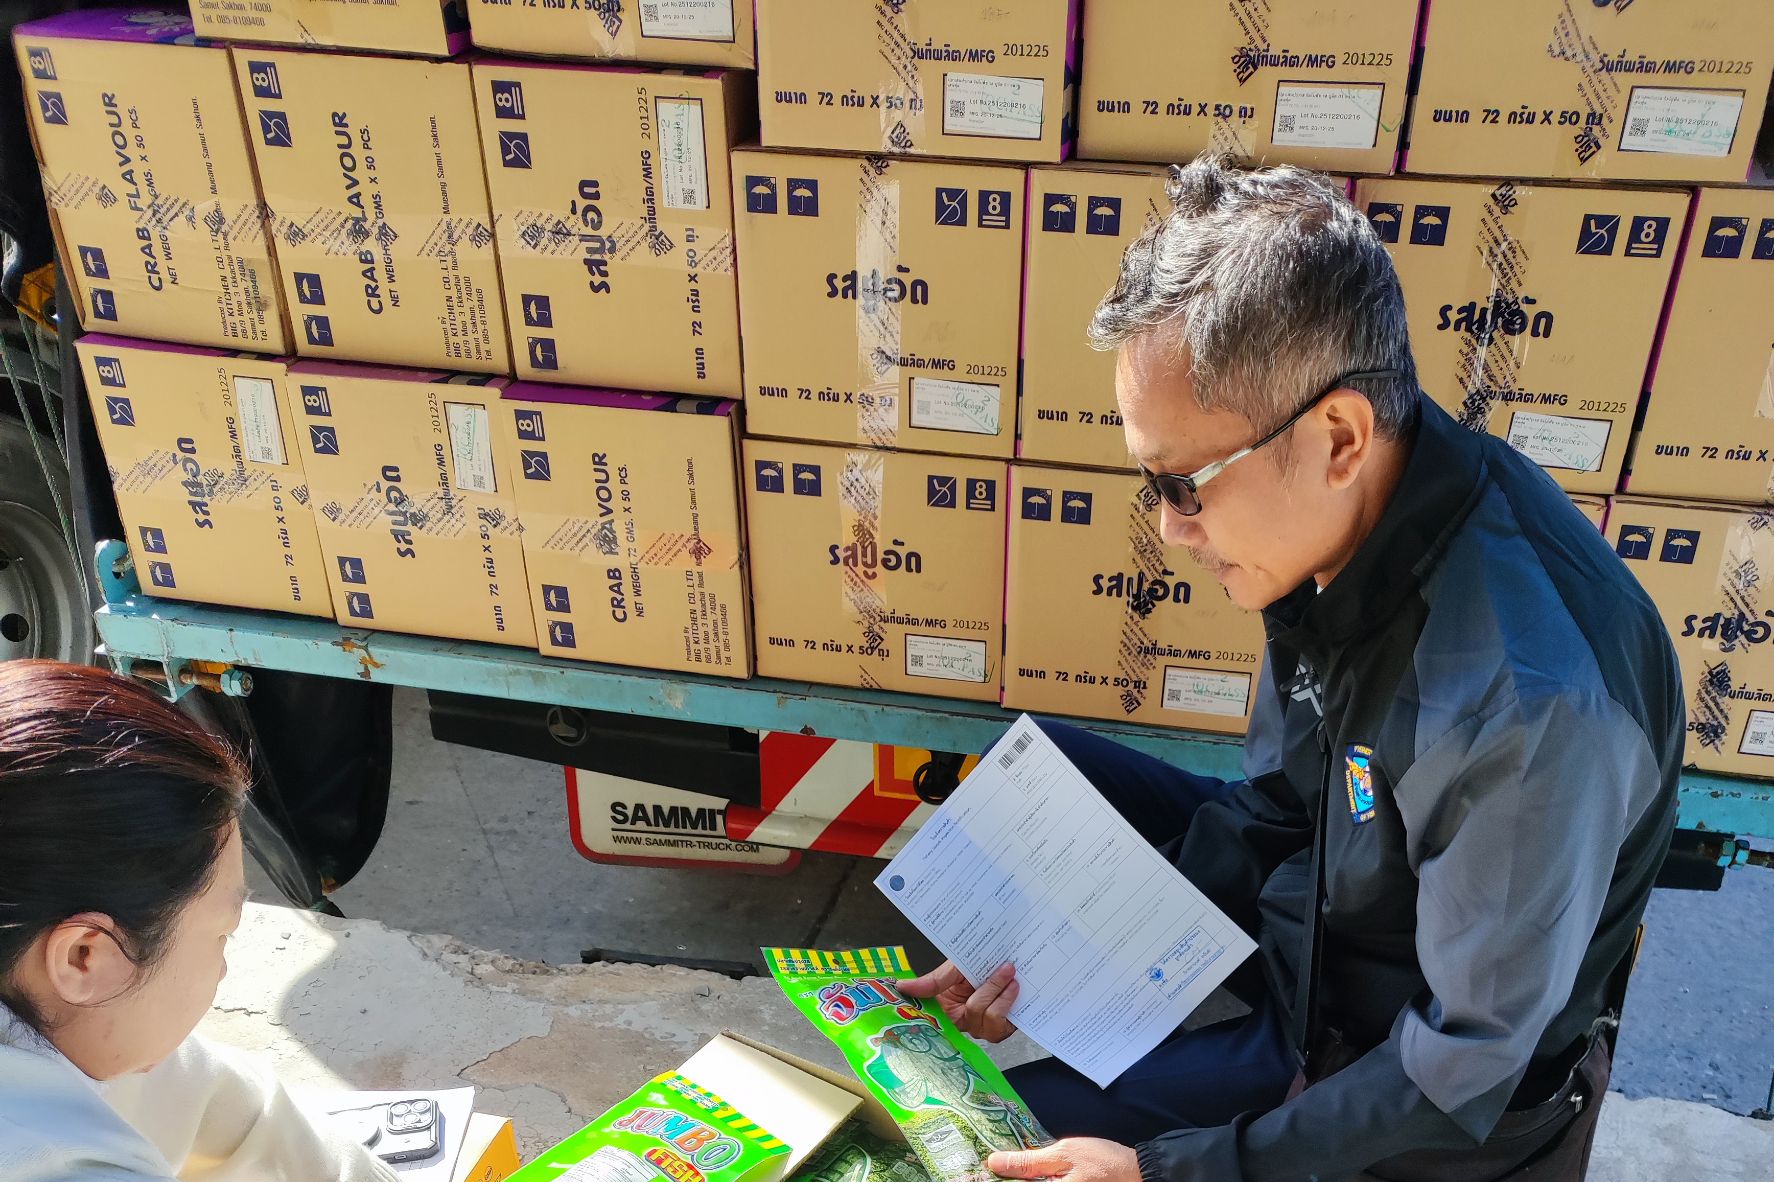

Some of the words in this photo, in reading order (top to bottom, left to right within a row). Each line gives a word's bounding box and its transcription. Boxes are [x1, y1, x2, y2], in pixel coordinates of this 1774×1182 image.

[1002, 43, 1049, 58] 201225
[1342, 51, 1394, 67] 201225
[1697, 58, 1754, 75] 201225
[252, 72, 269, 87] 8
[496, 92, 512, 108] 8
[774, 90, 808, 105] ขนาด
[817, 92, 834, 107] 72
[840, 88, 865, 108] กรัม
[869, 94, 880, 108] X
[1096, 99, 1131, 114] ขนาด
[1142, 100, 1159, 115] 72
[1166, 97, 1192, 117] กรัม
[1196, 102, 1208, 118] X
[1213, 103, 1234, 119] 50
[128, 105, 142, 130] PCS.
[637, 87, 650, 140] 201225
[1432, 108, 1470, 124] ขนาด
[1481, 108, 1500, 124] 72
[1507, 105, 1536, 125] กรัม
[1540, 110, 1553, 125] X
[1557, 110, 1580, 126] 50
[135, 134, 146, 150] 50
[198, 132, 211, 160] Samut
[359, 124, 375, 150] PCS.
[102, 91, 145, 213] FLAVOUR
[140, 154, 149, 163] X
[364, 156, 376, 171] 50
[432, 153, 445, 179] Samut
[369, 176, 379, 185] X
[987, 193, 1001, 215] 8
[1640, 220, 1657, 243] 8
[136, 226, 163, 291] CRAB
[686, 248, 697, 269] 50
[168, 265, 179, 285] NET
[237, 256, 246, 285] 74000
[687, 273, 699, 284] X
[359, 249, 384, 315] CRAB
[464, 276, 473, 303] 74000
[221, 275, 236, 317] KITCHEN
[388, 288, 401, 308] NET
[686, 287, 701, 314] กรัม
[449, 295, 460, 338] KITCHEN
[228, 322, 239, 338] BIG
[692, 320, 703, 337] 72
[454, 341, 463, 359] BIG
[696, 347, 706, 380] ขนาด
[965, 363, 1008, 378] 201225
[216, 367, 232, 407] 201225
[758, 385, 788, 399] ขนาด
[797, 388, 812, 400] 72
[818, 386, 840, 403] กรัม
[843, 391, 853, 404] X
[427, 392, 442, 434] 201225
[1037, 409, 1069, 422] ขนาด
[1078, 411, 1094, 424] 72
[1578, 399, 1628, 414] 201225
[517, 418, 533, 431] 8
[1654, 443, 1690, 458] ขนาด
[1700, 446, 1719, 459] 72
[1725, 444, 1752, 462] กรัม
[1755, 449, 1769, 463] X
[617, 464, 630, 486] PCS.
[621, 489, 631, 502] 50
[689, 487, 698, 511] Samut
[975, 481, 987, 499] 8
[272, 495, 284, 512] 50
[623, 506, 632, 514] X
[276, 516, 287, 525] X
[626, 518, 635, 543] GMS.
[278, 528, 291, 548] กรัม
[477, 524, 489, 541] 50
[482, 544, 492, 554] X
[629, 546, 638, 561] 72
[828, 538, 922, 580] รสปูอัด
[284, 553, 295, 567] 72
[482, 556, 495, 578] กรัม
[289, 575, 301, 602] ขนาด
[489, 582, 500, 597] 72
[606, 567, 628, 623] CRAB
[635, 605, 645, 618] NET
[708, 592, 716, 615] 74000
[491, 605, 505, 632] ขนาด
[690, 601, 700, 644] KITCHEN
[952, 619, 990, 631] 201225
[702, 626, 710, 640] Moo
[694, 645, 703, 663] BIG
[714, 643, 722, 666] Samut
[768, 636, 795, 648] ขนาด
[803, 639, 817, 650] 72
[822, 639, 843, 653] กรัม
[846, 644, 855, 654] X
[858, 645, 874, 656] 50
[1215, 650, 1257, 663] 201225
[1018, 667, 1046, 680] ขนาด
[1055, 670, 1069, 682] 72
[1075, 671, 1096, 685] กรัม
[1099, 676, 1109, 687] X
[1112, 677, 1128, 688] 50
[610, 801, 727, 832] SAMMIT
[612, 835, 760, 853] WWW.SAMMITR-TRUCK.COM
[615, 1109, 740, 1169] JUMBO
